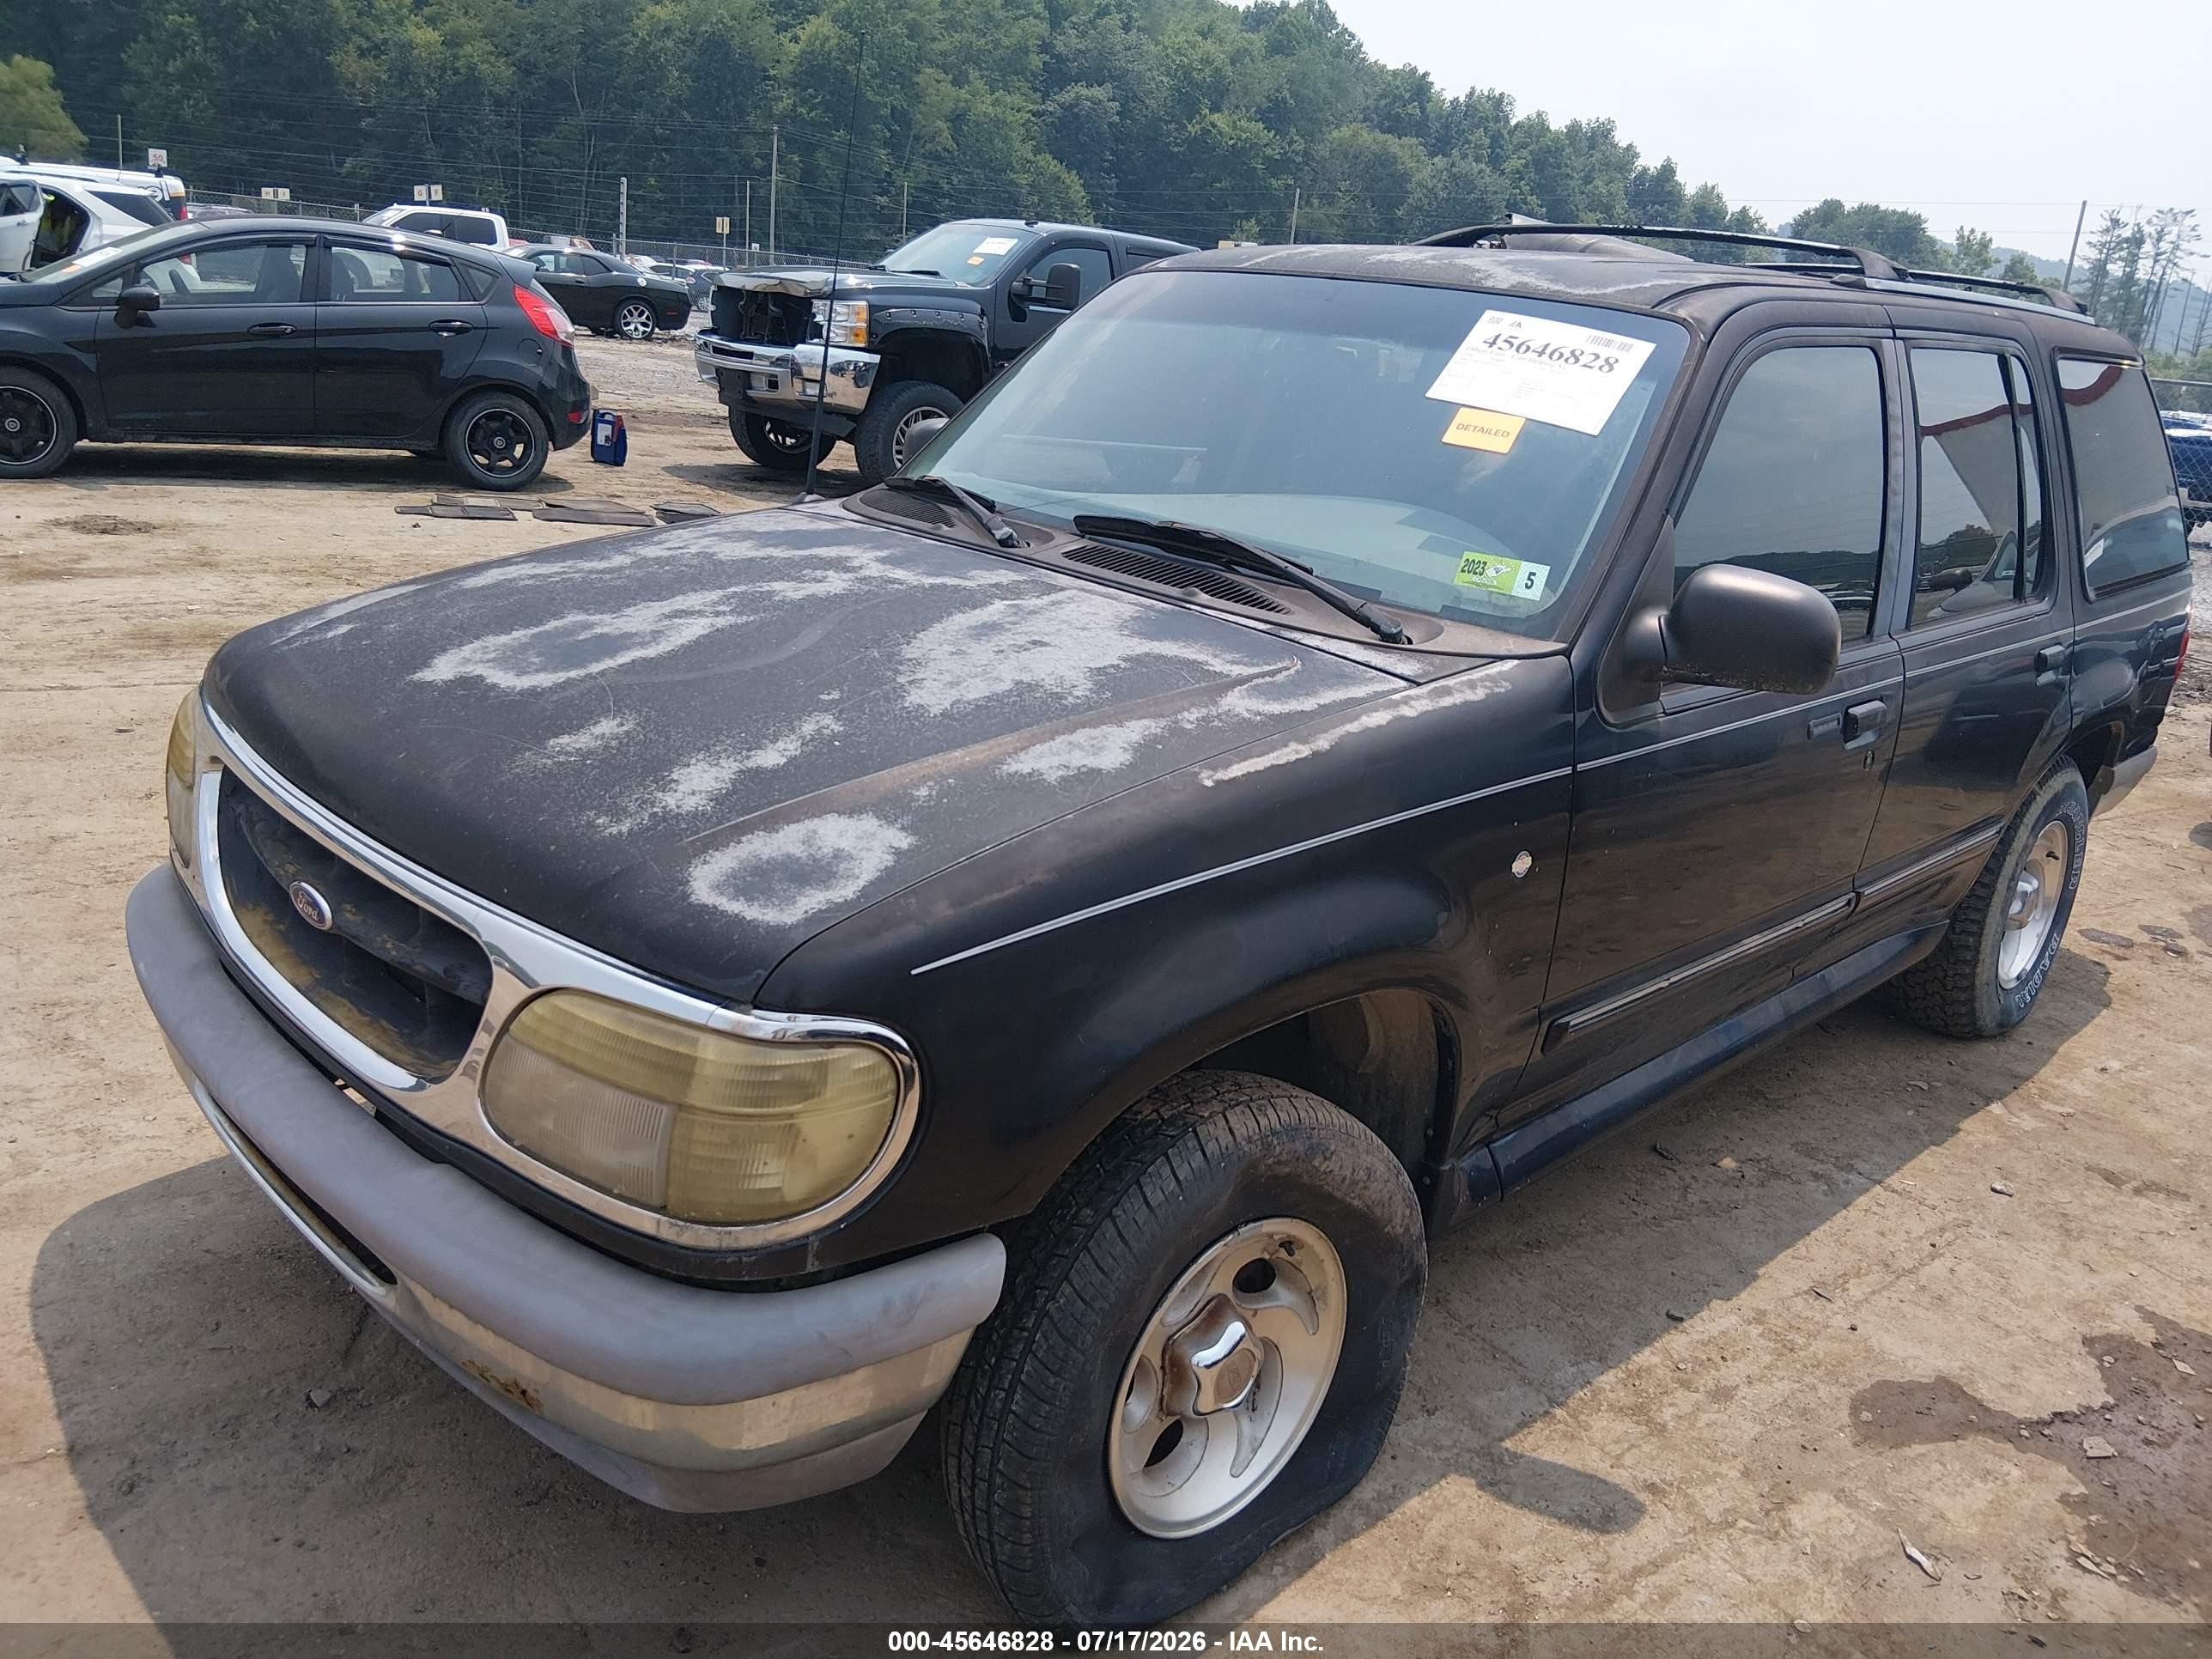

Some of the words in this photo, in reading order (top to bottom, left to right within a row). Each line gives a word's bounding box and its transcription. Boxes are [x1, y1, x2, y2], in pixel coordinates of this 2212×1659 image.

[1483, 332, 1620, 374] 45646828
[1455, 422, 1510, 438] DETAILED
[1461, 558, 1487, 577] 2023
[1524, 571, 1537, 590] 5
[296, 890, 319, 921] Ford
[2014, 933, 2060, 1008] RADIAL
